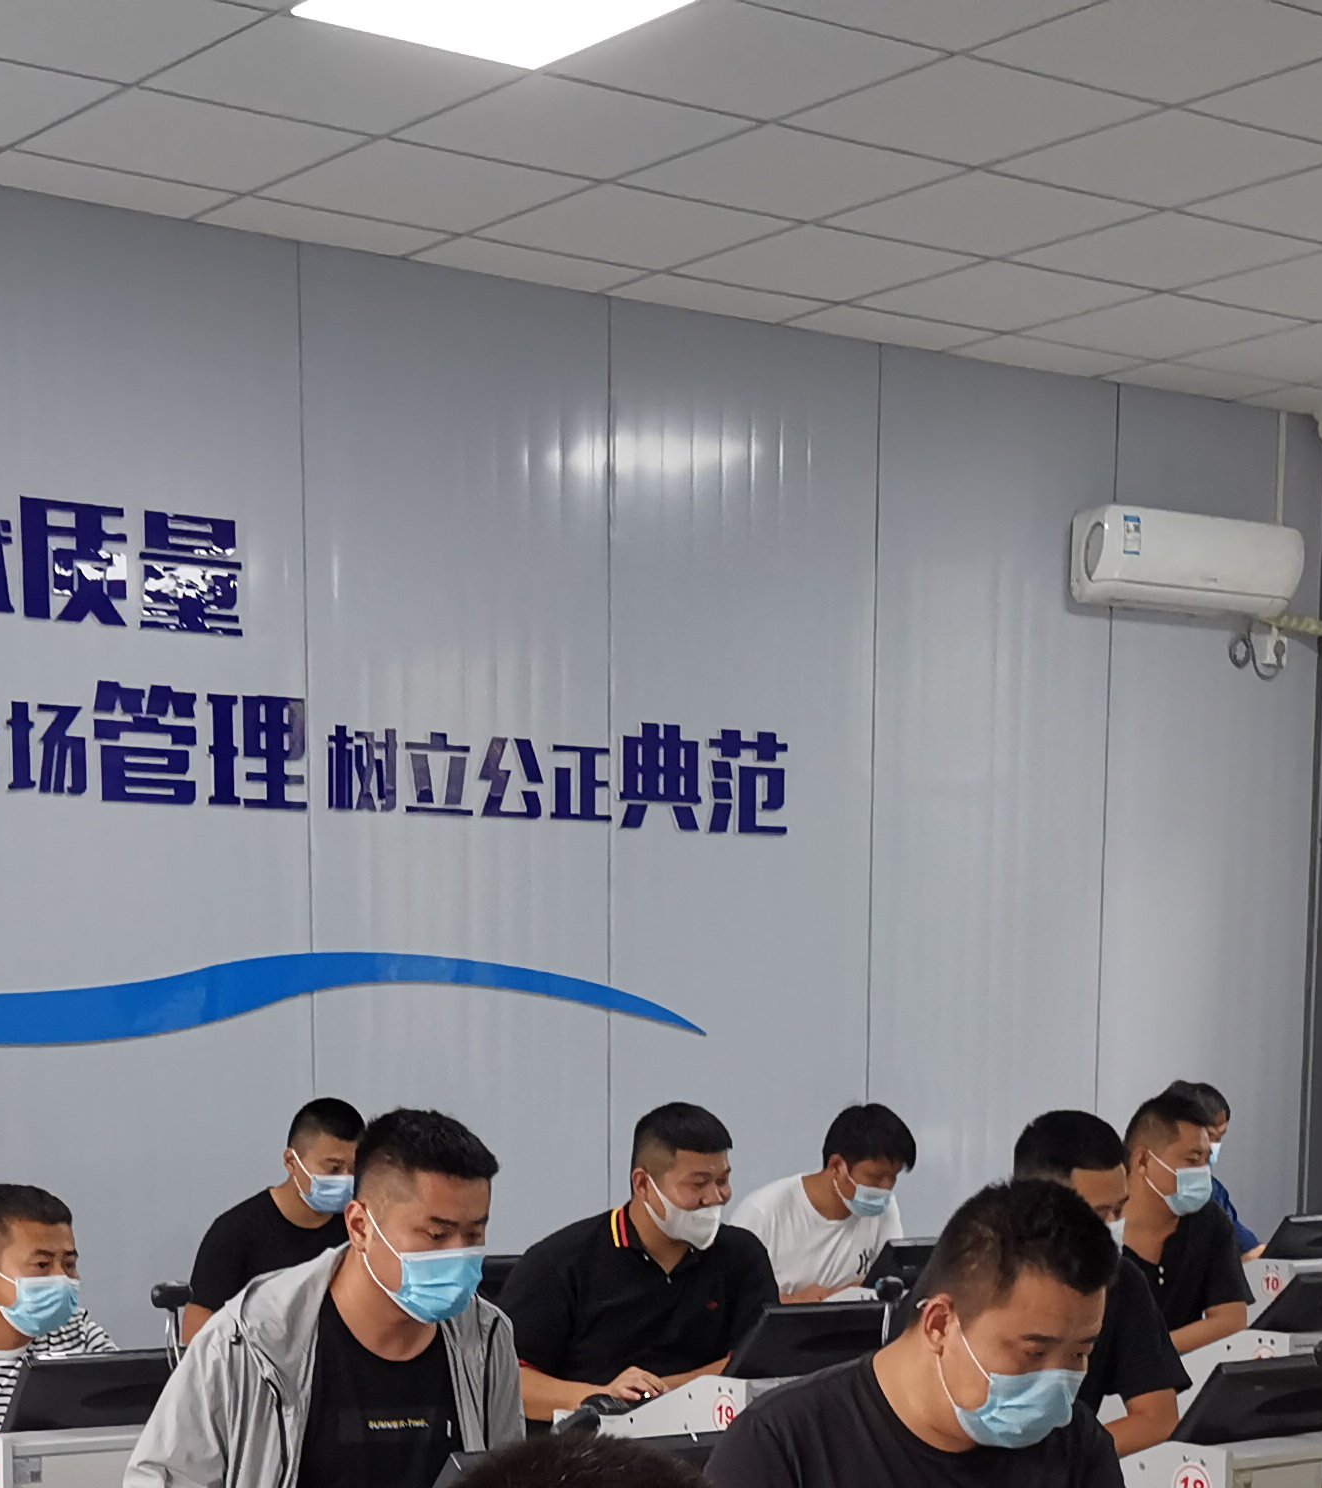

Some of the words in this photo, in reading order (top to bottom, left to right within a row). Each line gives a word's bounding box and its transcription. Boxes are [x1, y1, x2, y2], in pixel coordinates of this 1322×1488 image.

[325, 721, 789, 836] 树立公正典范
[1264, 1276, 1280, 1292] 10
